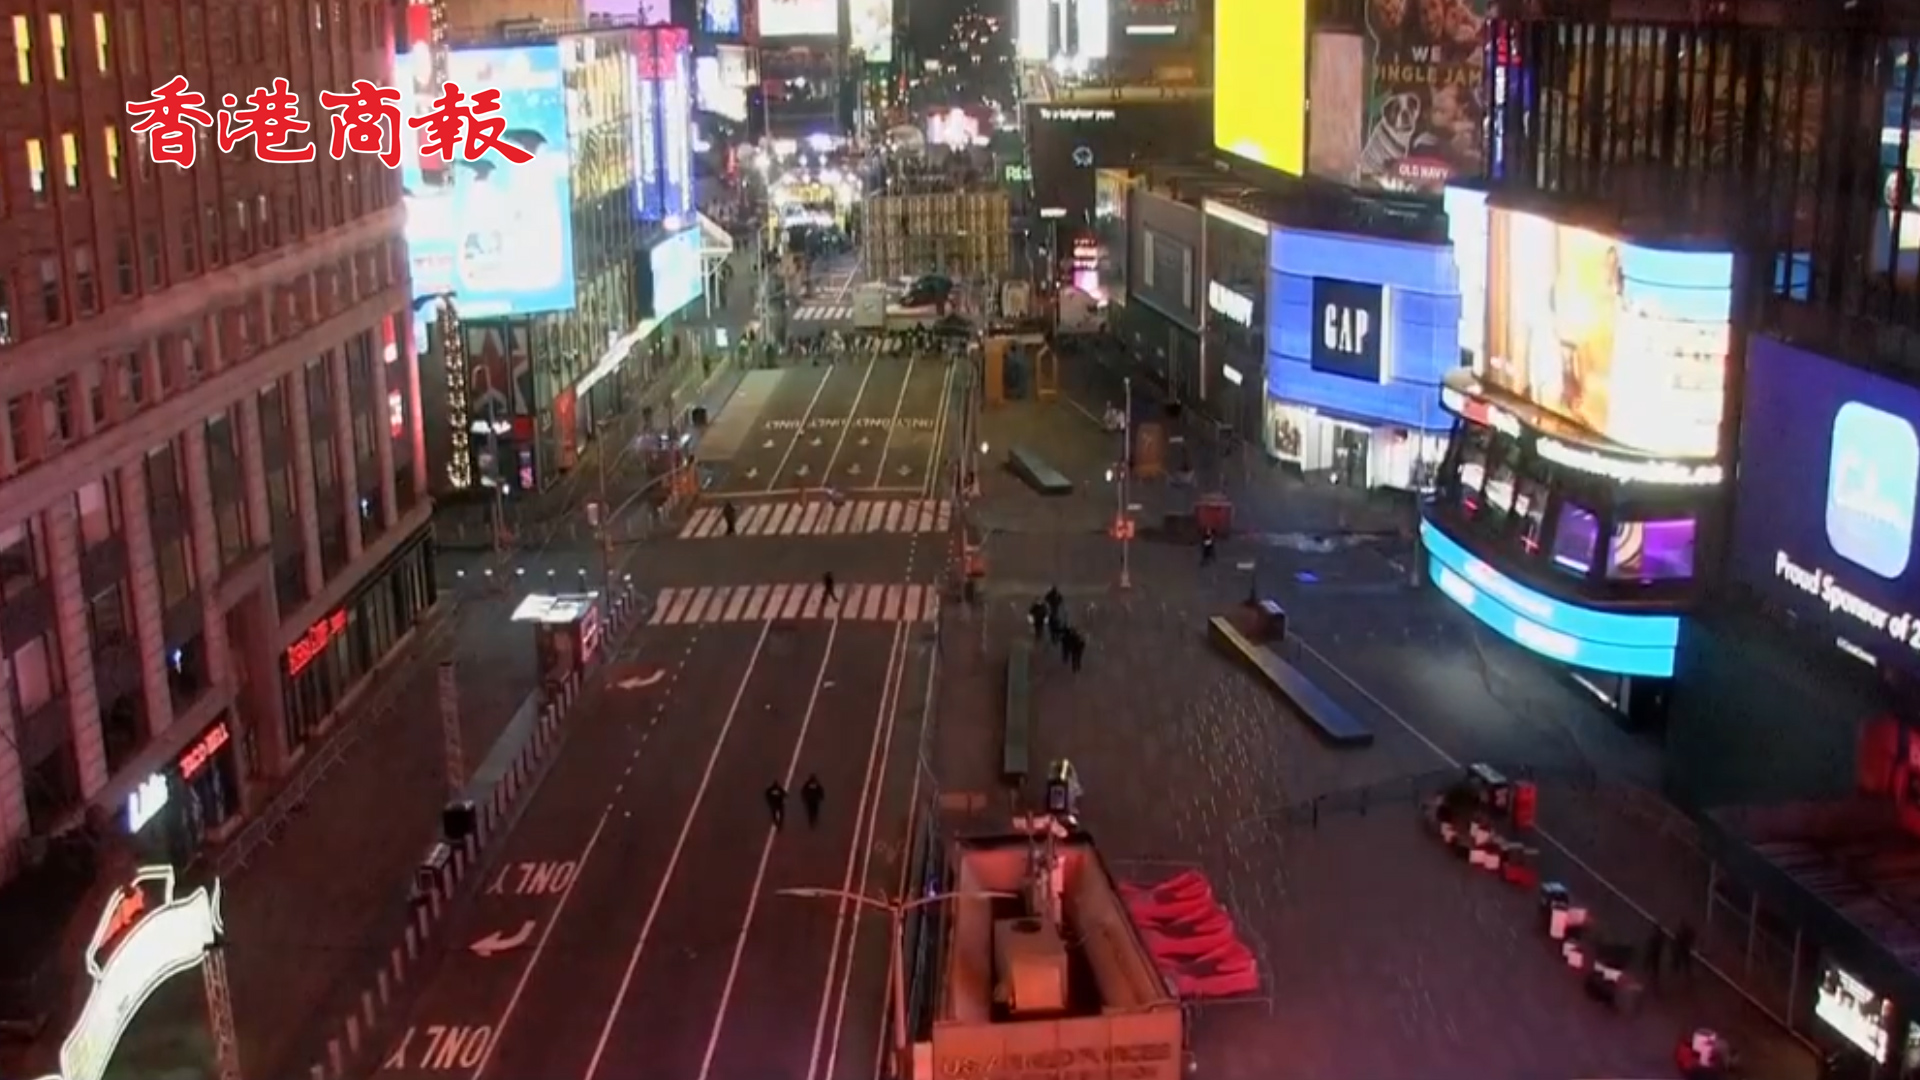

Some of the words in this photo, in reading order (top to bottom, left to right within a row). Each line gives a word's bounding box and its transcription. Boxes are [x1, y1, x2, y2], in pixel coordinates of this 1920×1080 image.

[1412, 46, 1442, 63] WE
[1444, 67, 1482, 86] JAM
[1399, 164, 1420, 176] OLD
[1421, 167, 1449, 179] NAVY
[1324, 303, 1370, 355] GAP
[1775, 549, 1822, 595] Proud
[1821, 574, 1889, 630] Sponsor
[1888, 612, 1912, 642] of
[485, 861, 577, 894] ONLY
[384, 1025, 491, 1069] ONLY
